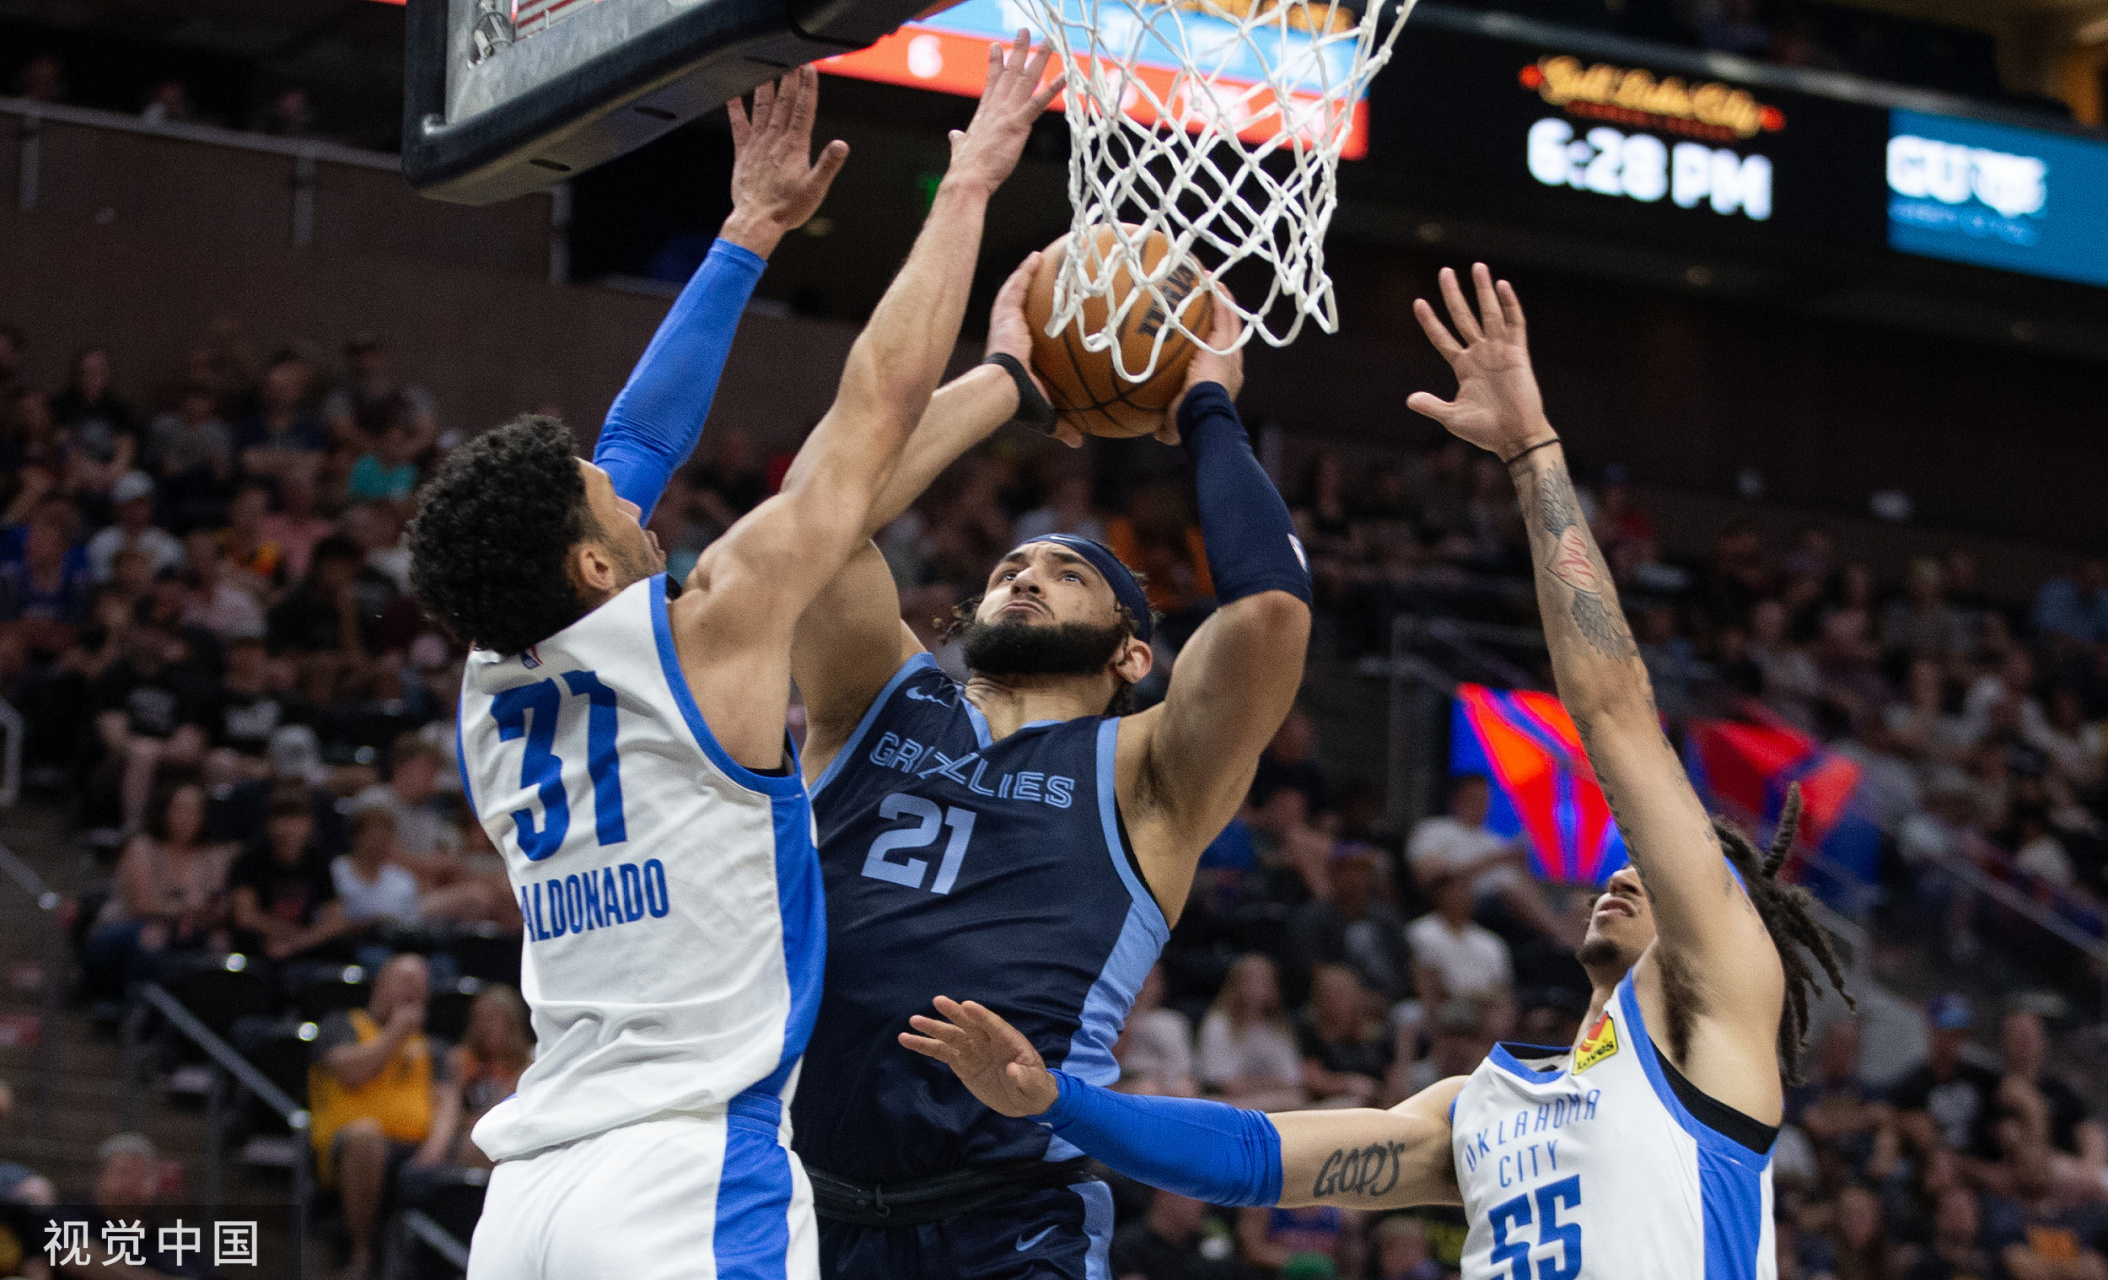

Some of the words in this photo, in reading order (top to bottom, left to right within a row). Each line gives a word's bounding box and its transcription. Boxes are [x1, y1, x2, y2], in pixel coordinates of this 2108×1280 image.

[1671, 141, 1774, 221] PM
[490, 670, 627, 861] 31
[861, 793, 977, 895] 21
[1465, 1089, 1601, 1173] OKLAHOMA
[1499, 1139, 1559, 1188] CITY
[1488, 1174, 1582, 1280] 55
